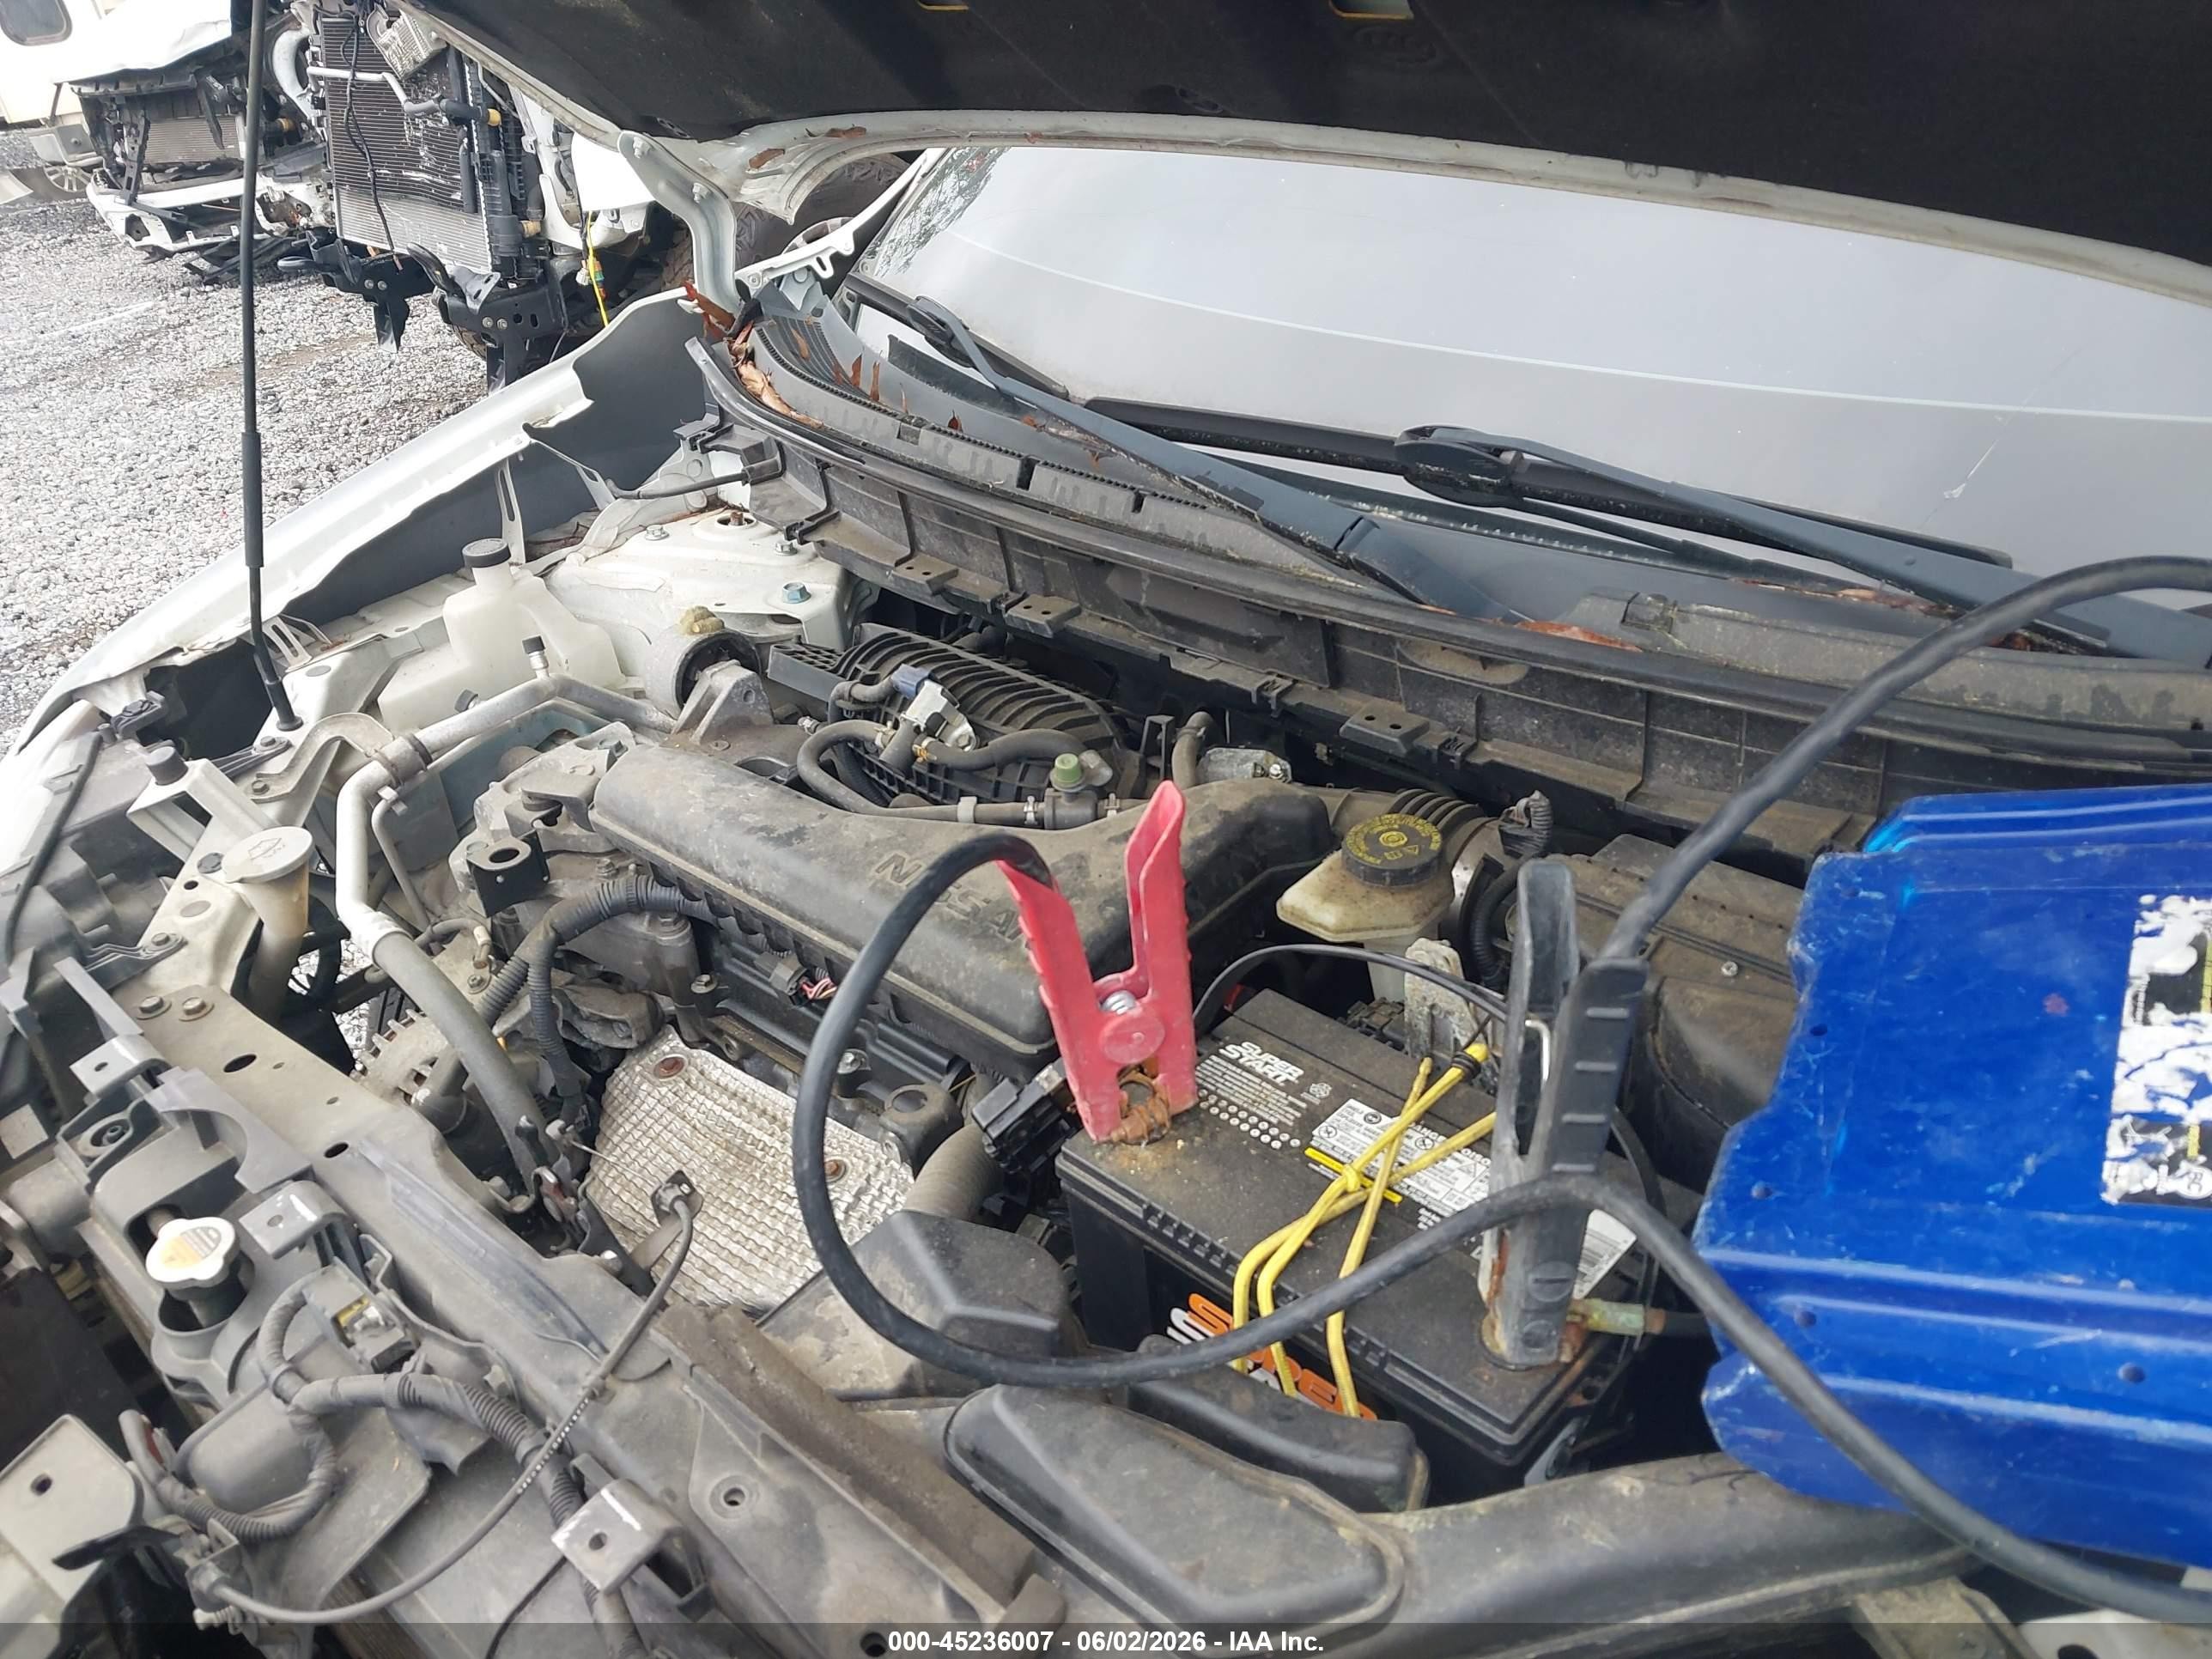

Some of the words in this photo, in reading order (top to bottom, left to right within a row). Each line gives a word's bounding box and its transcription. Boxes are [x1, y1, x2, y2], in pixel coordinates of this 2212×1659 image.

[874, 851, 1030, 950] NSA
[1218, 1044, 1290, 1083] START
[1239, 1040, 1304, 1080] SUPER
[1188, 1292, 1378, 1421] SPE
